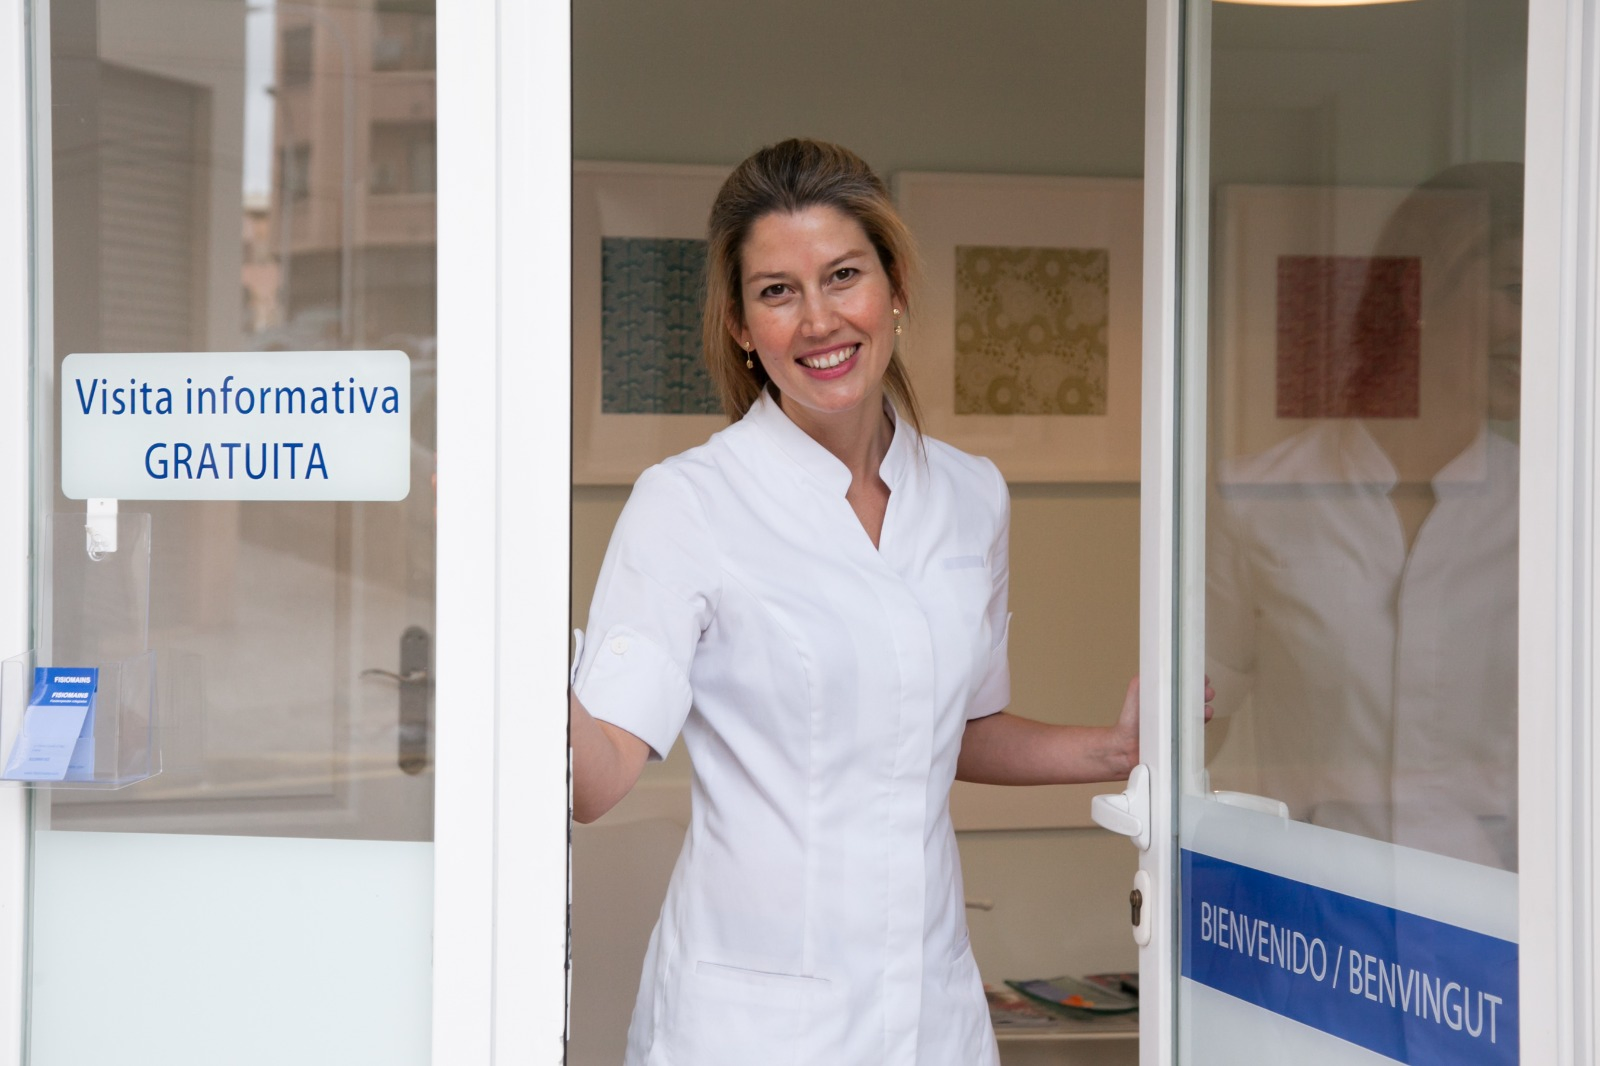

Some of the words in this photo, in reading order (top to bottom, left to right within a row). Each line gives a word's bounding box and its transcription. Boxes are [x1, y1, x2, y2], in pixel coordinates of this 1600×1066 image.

[75, 377, 173, 415] Visita
[186, 375, 399, 415] informativa
[144, 442, 329, 480] GRATUITA
[54, 676, 91, 684] FISIOMAINS
[1201, 901, 1327, 982] BIENVENIDO
[1333, 945, 1343, 989] /
[1350, 949, 1503, 1044] BENVINGUT
